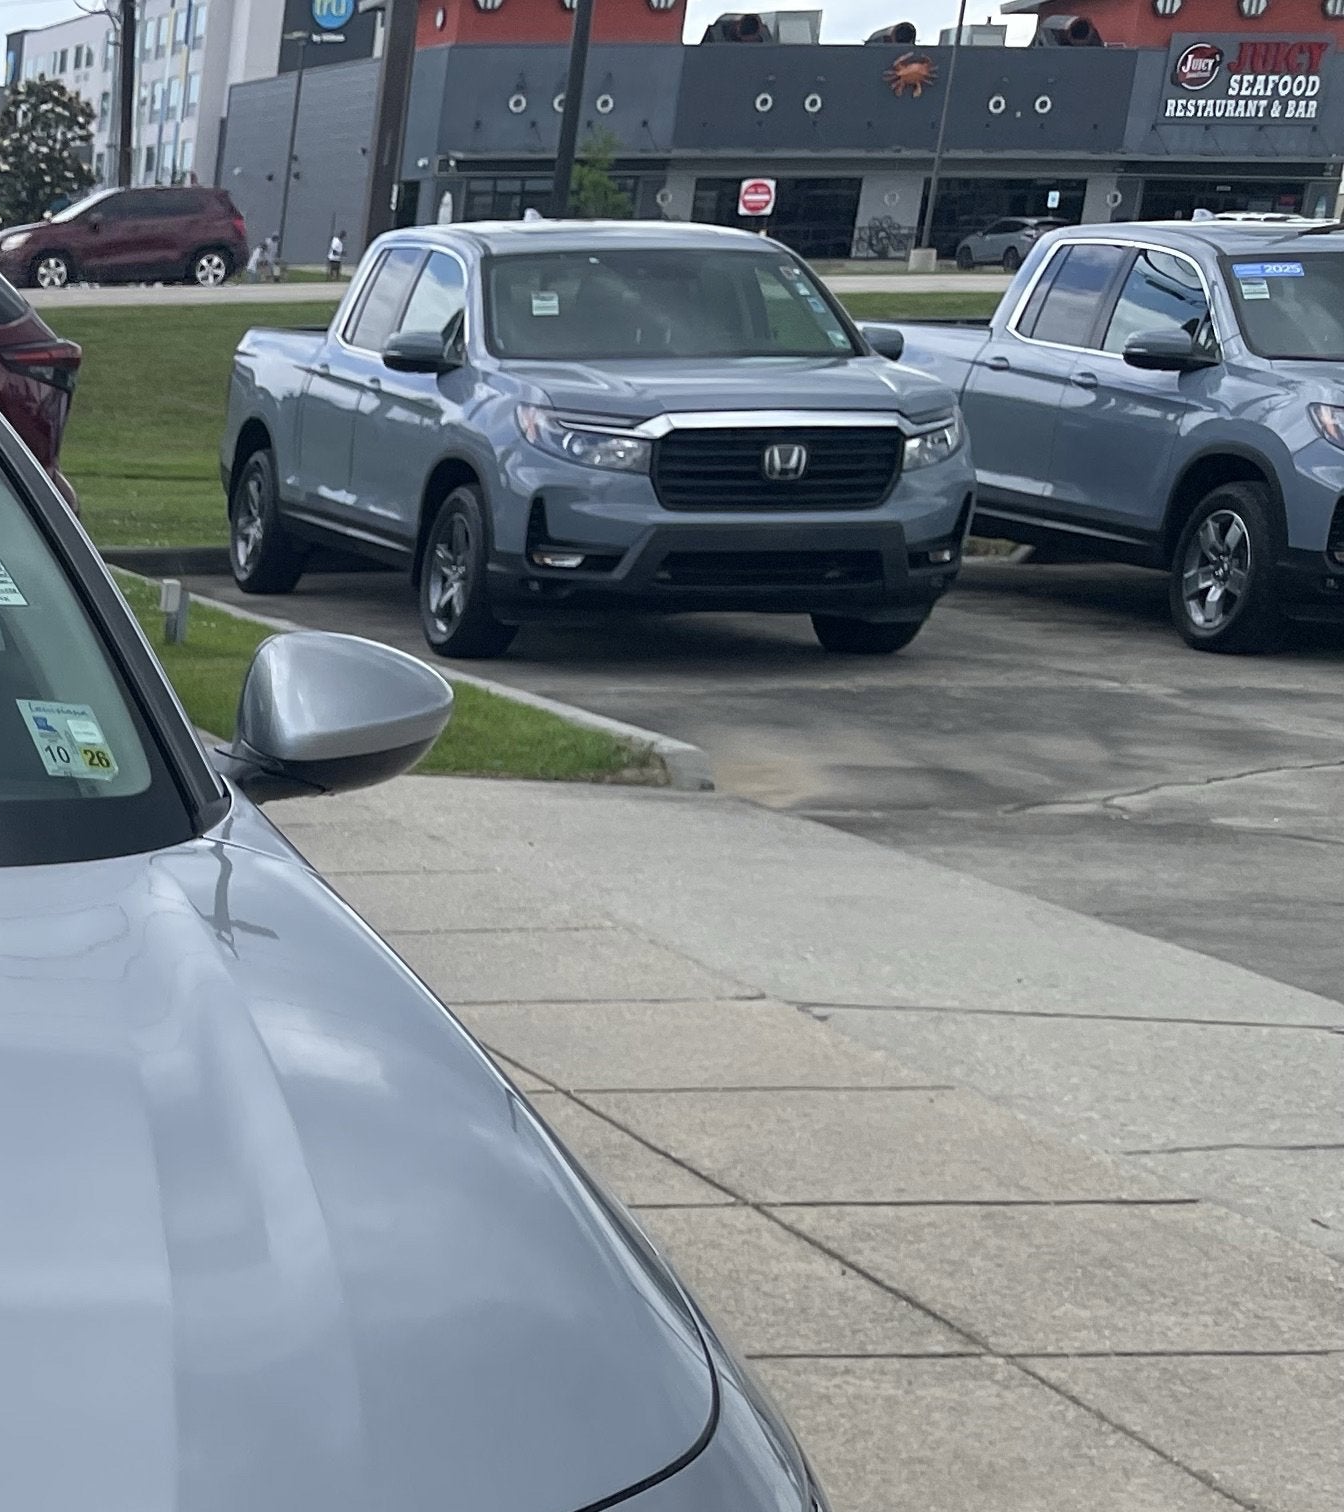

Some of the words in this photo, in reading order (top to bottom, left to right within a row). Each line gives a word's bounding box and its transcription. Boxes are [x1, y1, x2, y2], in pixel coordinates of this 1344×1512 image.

[1227, 42, 1328, 73] JUICY
[1228, 75, 1320, 97] SEAFOOD
[1165, 99, 1268, 118] RESTAURANT
[1270, 100, 1282, 118] &
[1285, 100, 1318, 118] BAR
[1264, 264, 1301, 274] 2025
[45, 745, 70, 764] 10
[83, 749, 111, 769] 26
